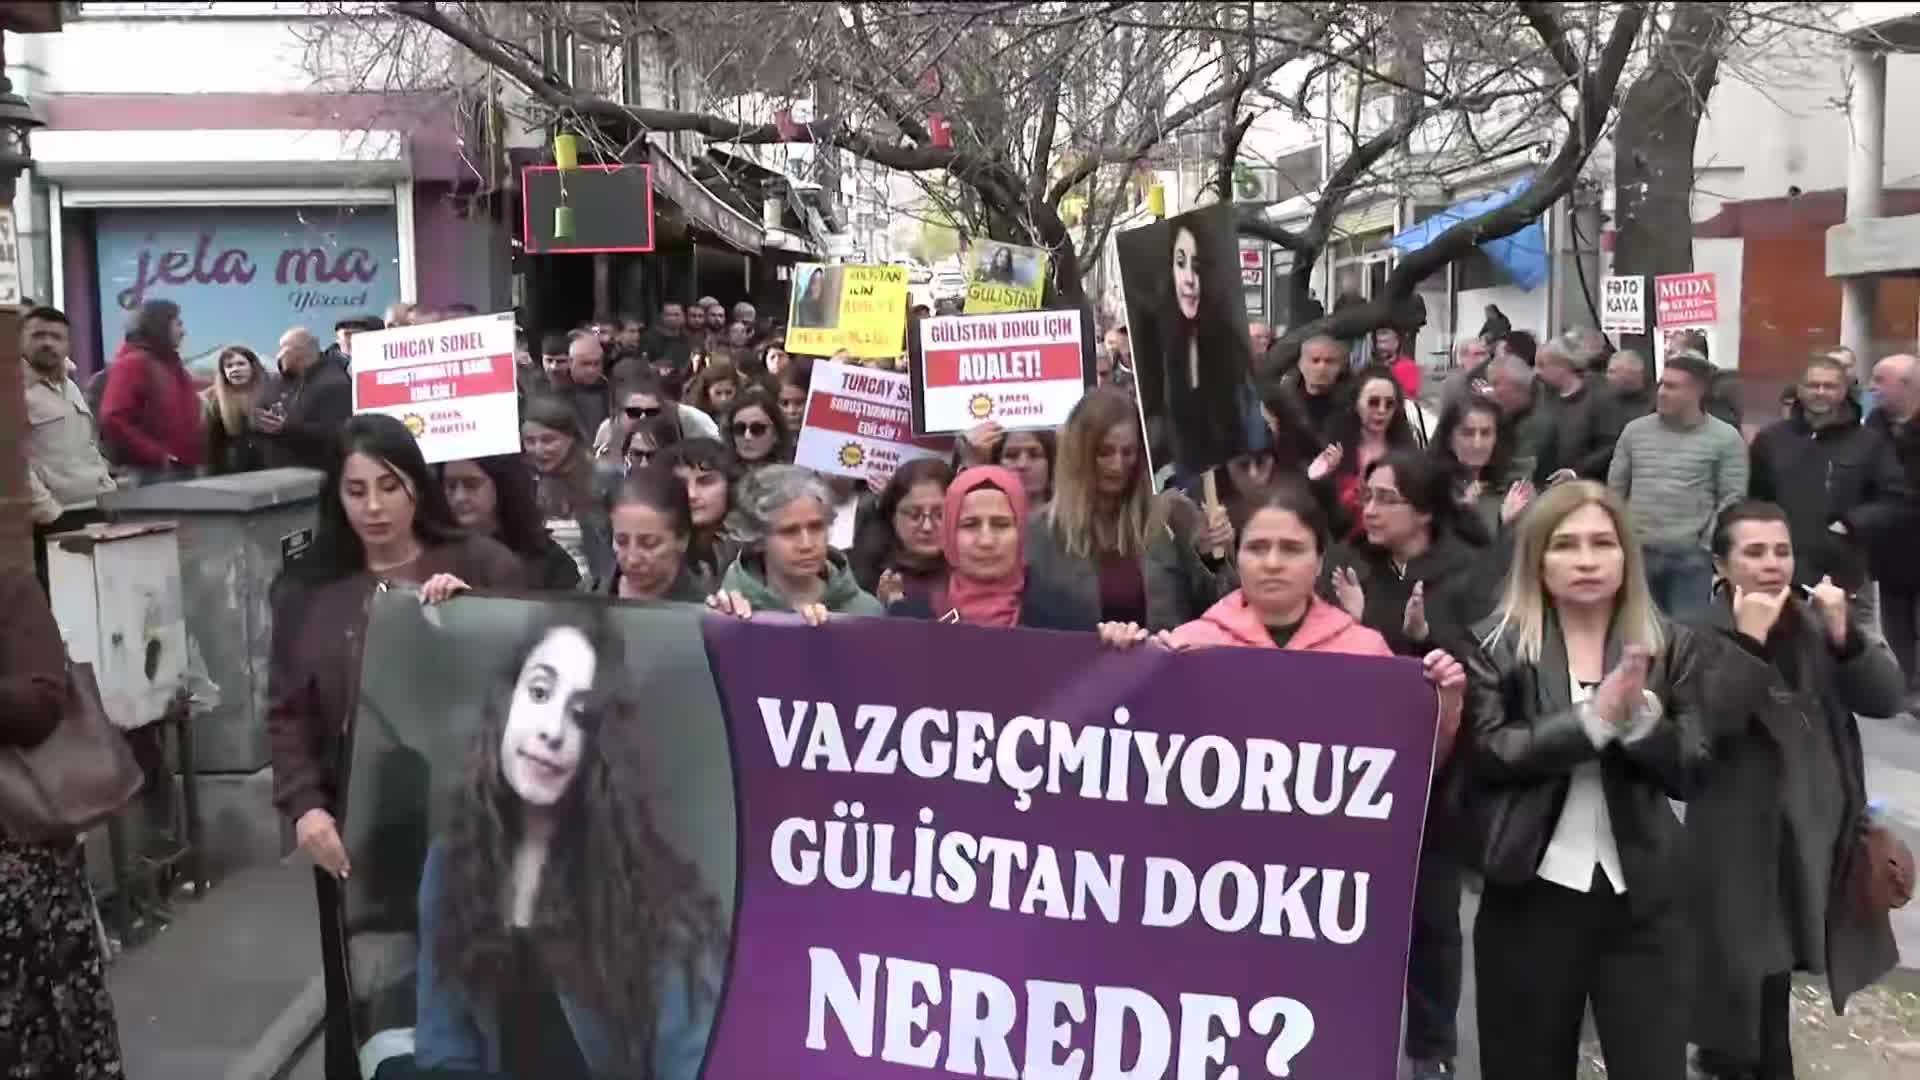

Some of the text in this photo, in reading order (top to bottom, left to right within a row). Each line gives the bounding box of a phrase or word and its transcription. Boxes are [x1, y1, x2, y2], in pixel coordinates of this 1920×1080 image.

[117, 231, 378, 310] jela ma
[1607, 280, 1638, 294] FOTO
[1662, 279, 1712, 297] MODA
[1607, 297, 1638, 312] KAYA
[931, 315, 1072, 343] GÜLİSTAN DOKU İÇİN
[384, 331, 484, 361] TUNCAY SONEL
[958, 350, 1042, 382] ADALET!
[842, 373, 895, 397] TUNCAY
[867, 461, 896, 473] PART
[758, 697, 1396, 820] VAZGEÇMİYORUZ
[771, 801, 1370, 944] GÜLİSTAN DOKU
[805, 947, 1315, 1080] NEREDE?
